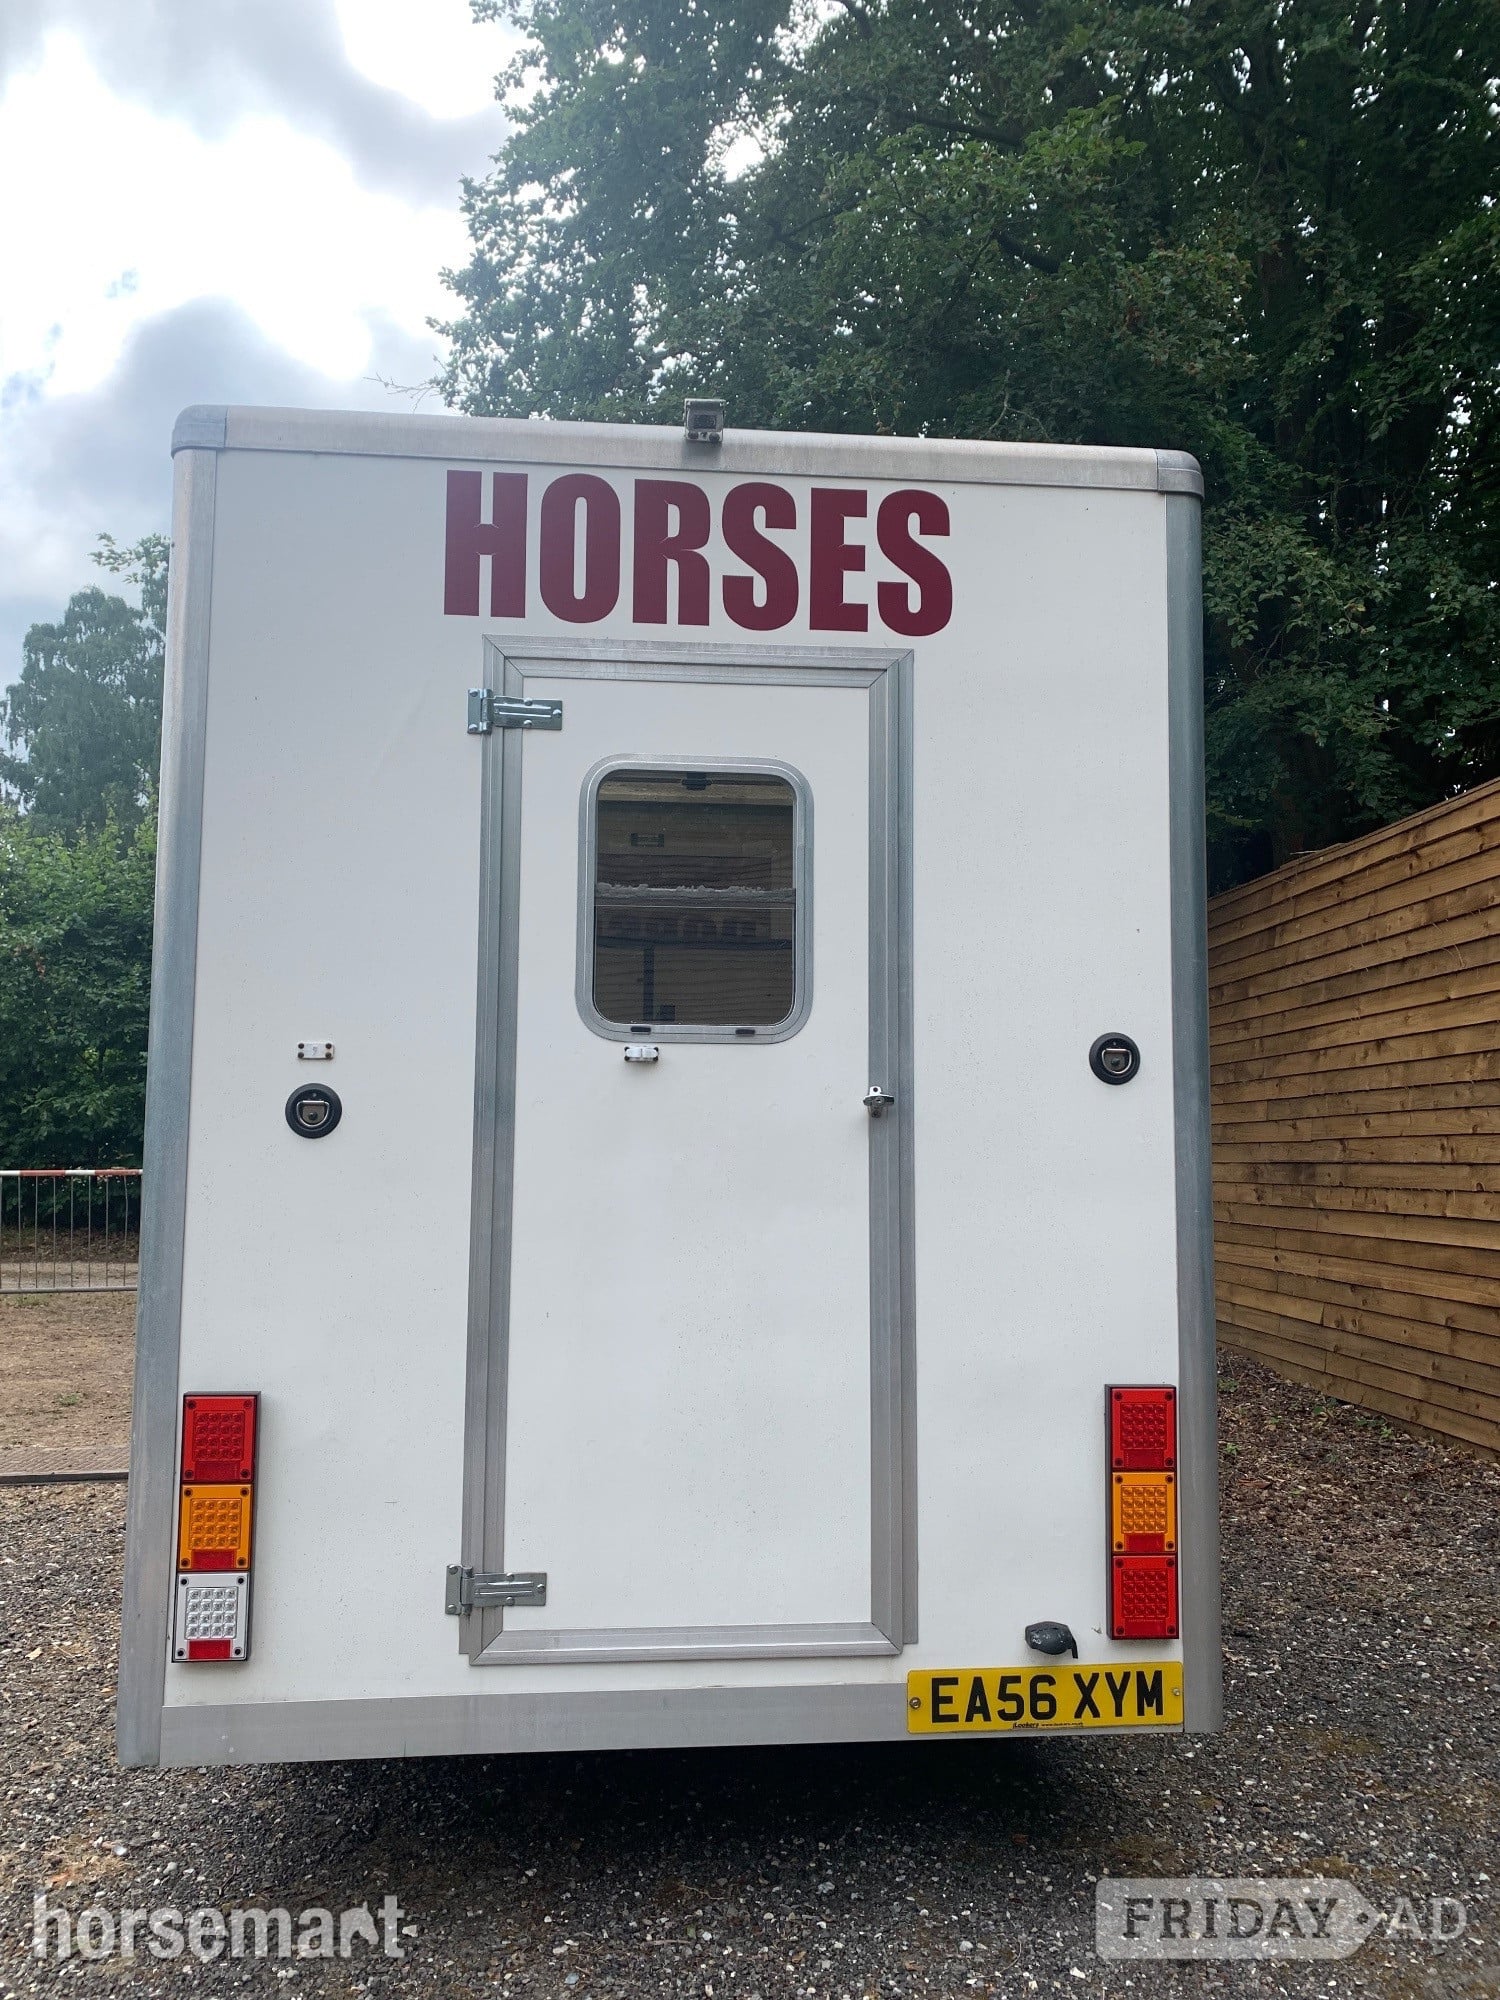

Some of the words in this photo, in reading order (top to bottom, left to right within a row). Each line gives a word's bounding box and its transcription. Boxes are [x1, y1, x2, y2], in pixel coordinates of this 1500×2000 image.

[444, 469, 953, 636] HORSES
[931, 1674, 1057, 1723] EA56
[1073, 1669, 1164, 1719] XYM
